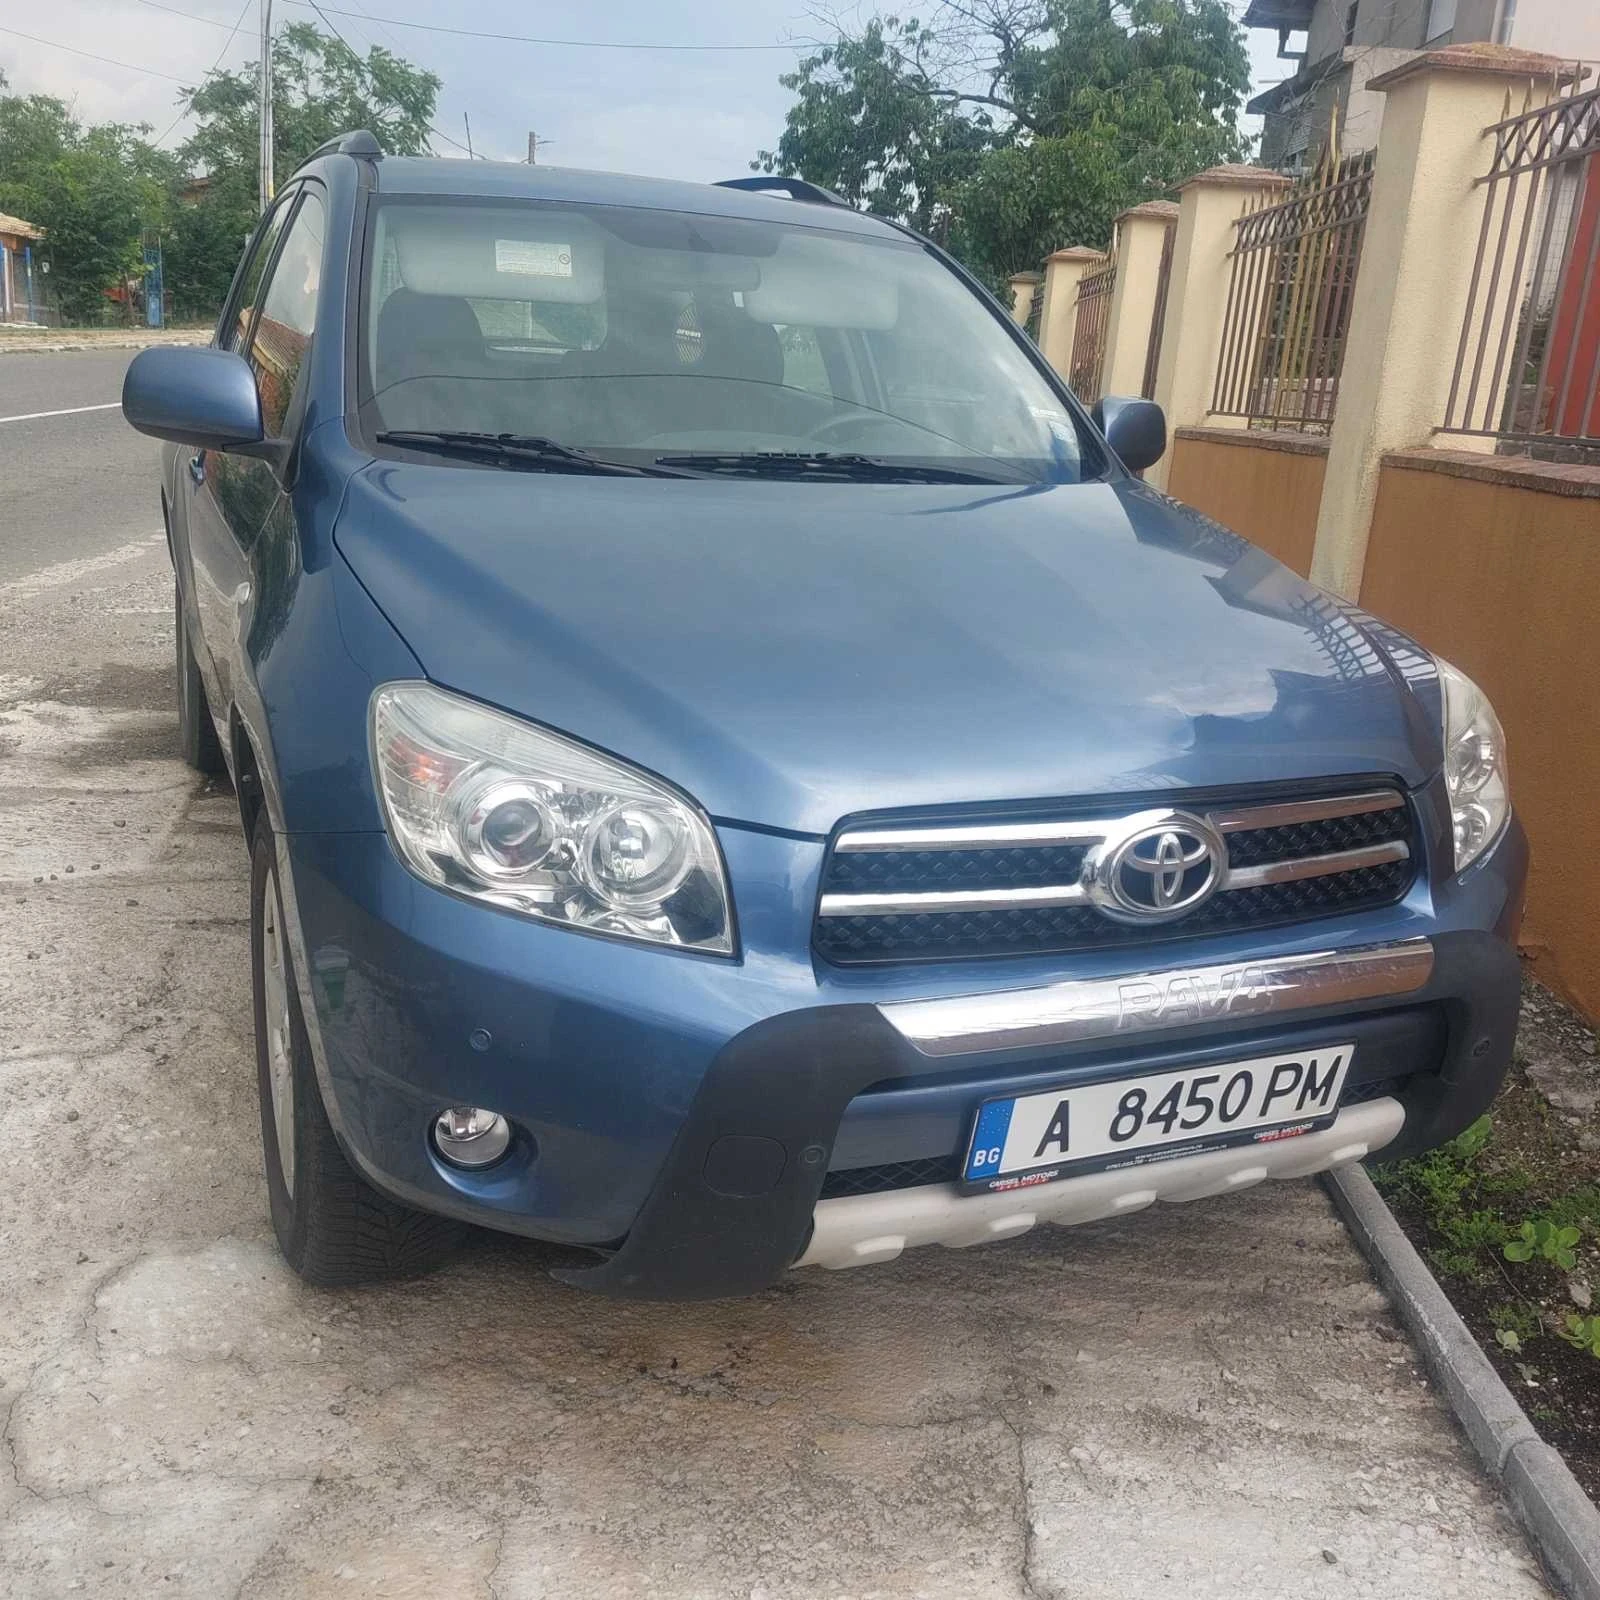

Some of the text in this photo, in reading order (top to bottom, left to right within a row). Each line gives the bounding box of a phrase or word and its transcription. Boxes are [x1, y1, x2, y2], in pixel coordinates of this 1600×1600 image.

[1118, 966, 1273, 1028] RAV4
[1033, 1100, 1070, 1158] A
[1109, 1071, 1253, 1142] 8450
[1259, 1055, 1342, 1116] PM
[973, 1148, 999, 1167] BG
